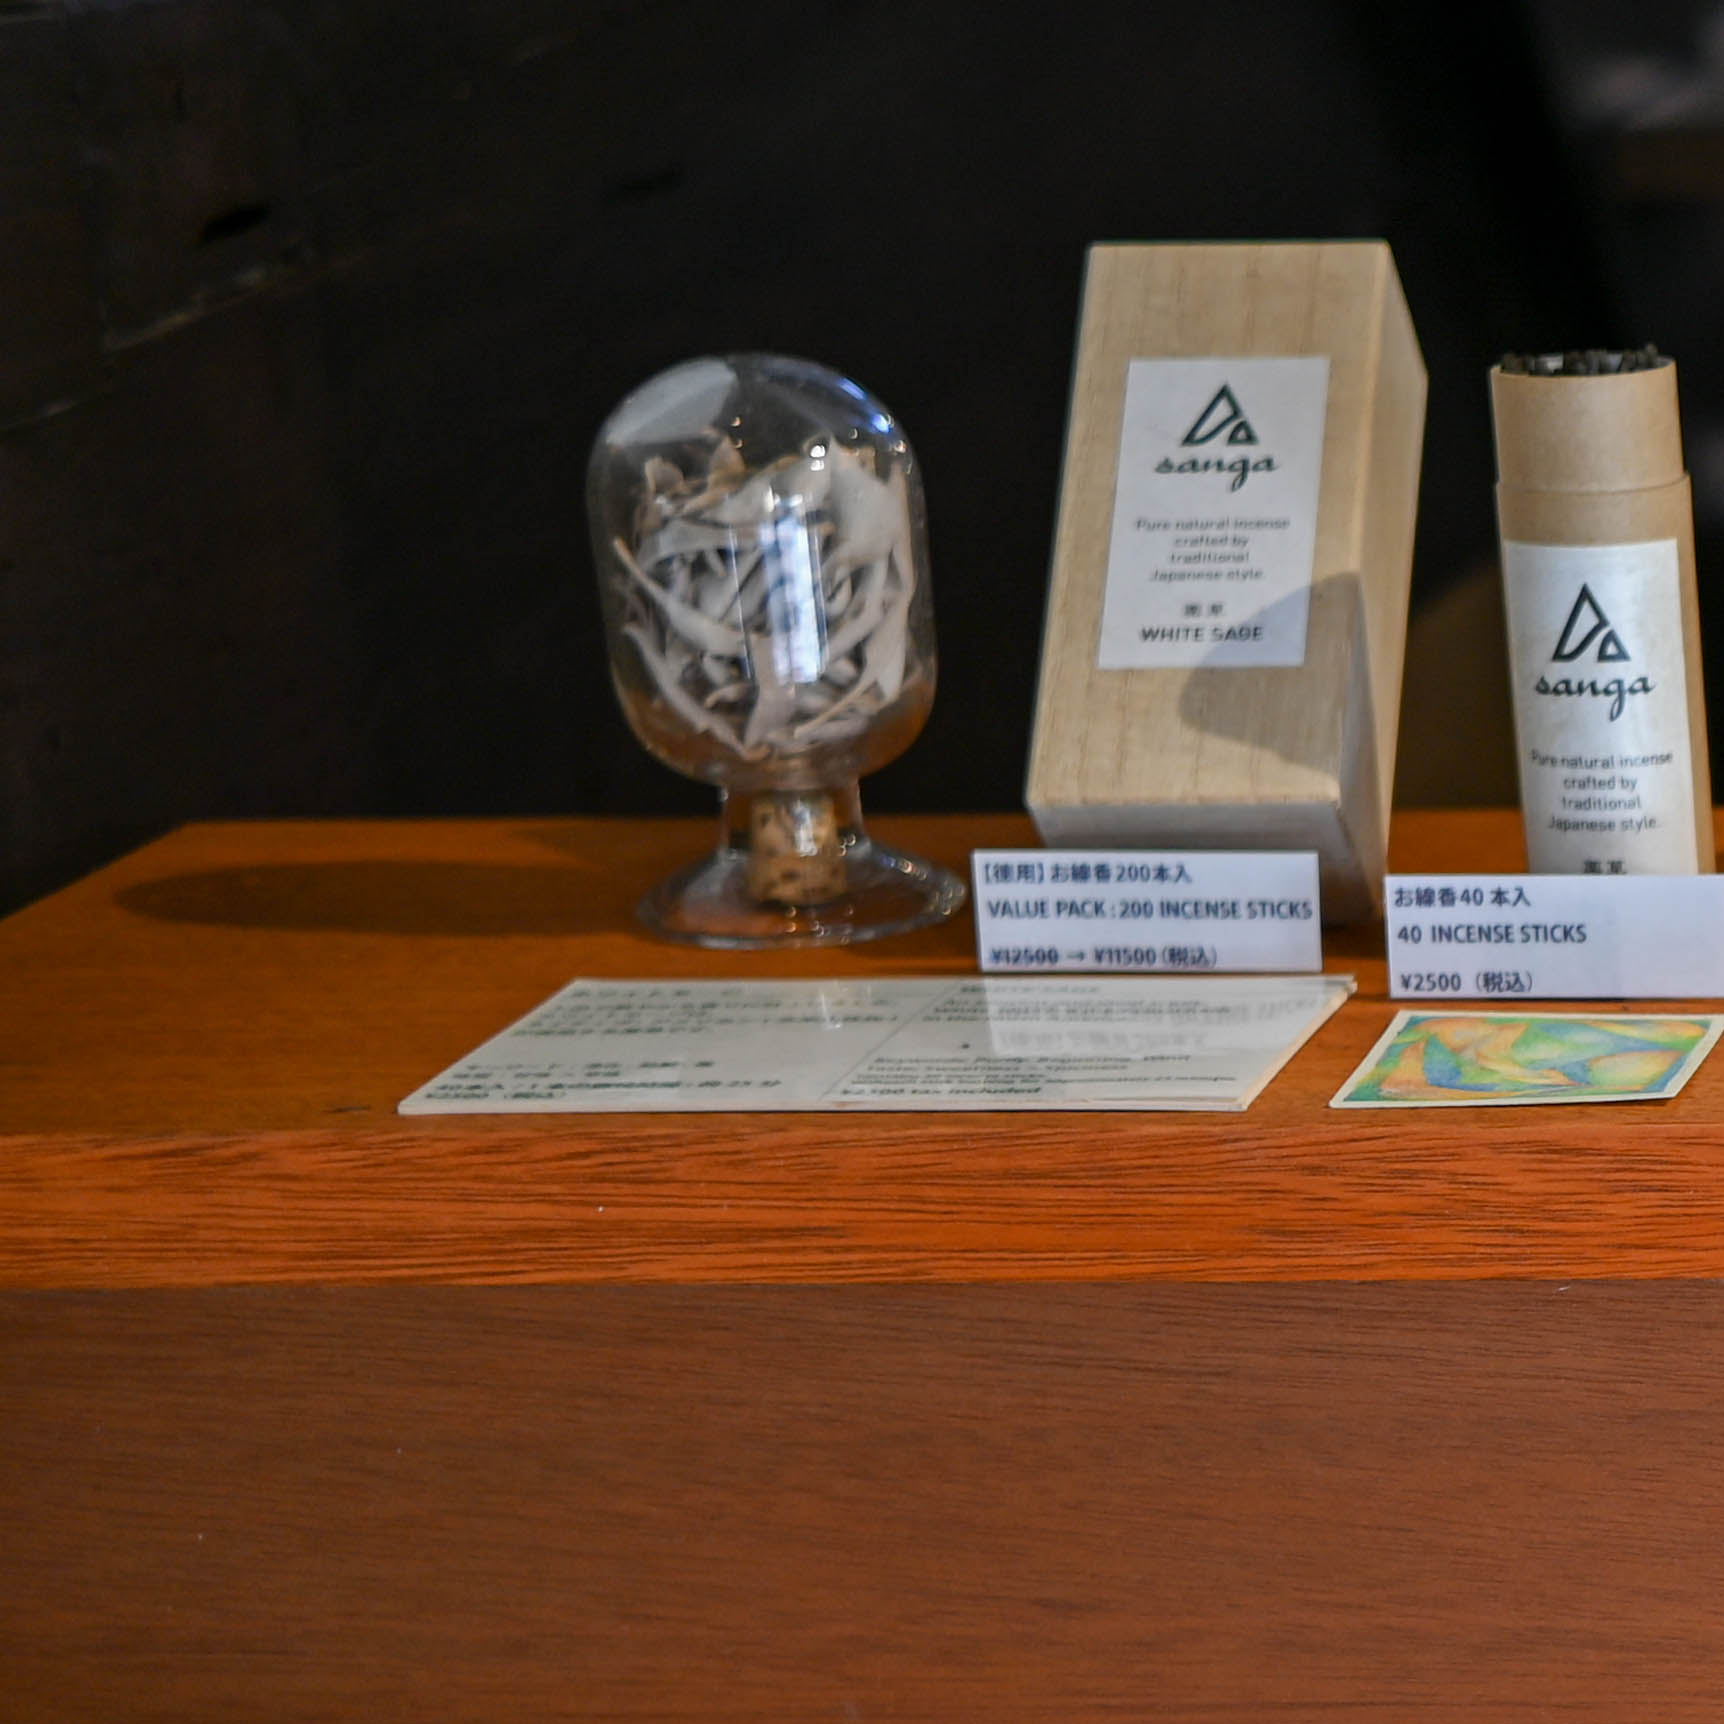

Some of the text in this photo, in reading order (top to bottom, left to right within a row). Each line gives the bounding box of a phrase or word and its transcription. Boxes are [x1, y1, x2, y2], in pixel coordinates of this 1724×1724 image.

[1155, 457, 1279, 492] sanga
[1141, 628, 1202, 641] WHITE
[1536, 677, 1657, 721] sanga
[1531, 749, 1673, 769] Pure natural incense
[1564, 776, 1637, 792] crafted by
[1562, 796, 1641, 810] traditional
[1549, 817, 1615, 832] Japanese
[1398, 924, 1587, 944] 40 INCENSE STICKS
[1401, 973, 1461, 990] ¥2500
